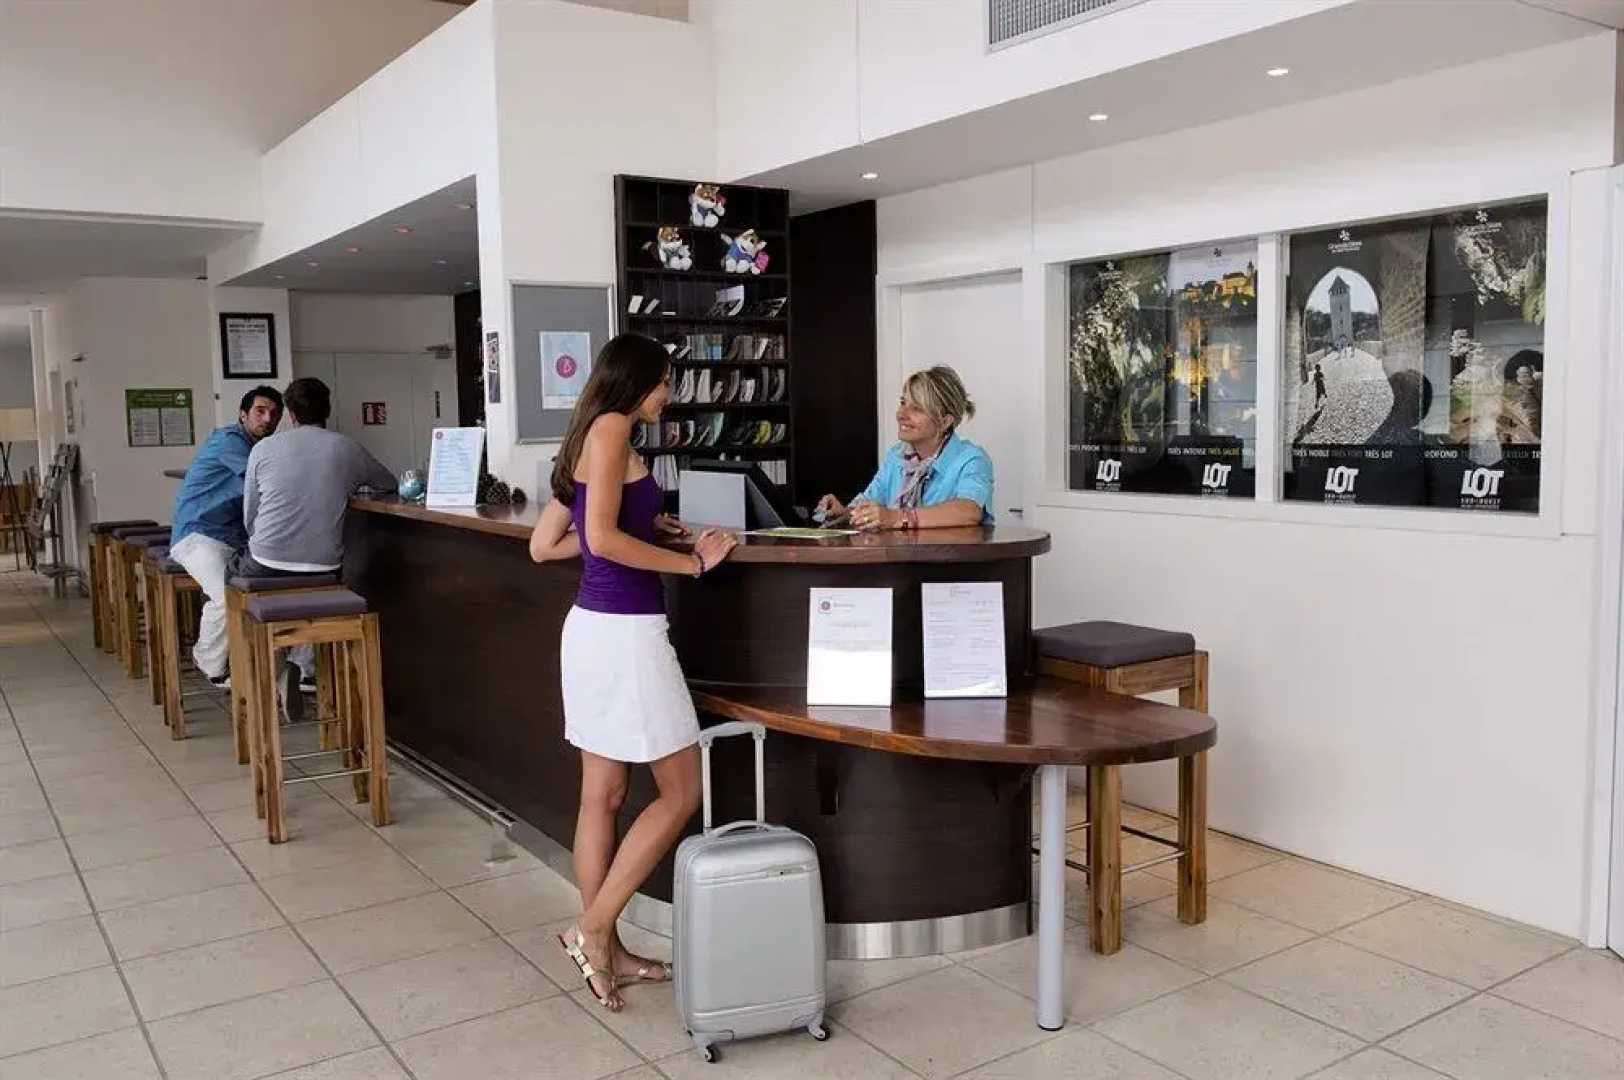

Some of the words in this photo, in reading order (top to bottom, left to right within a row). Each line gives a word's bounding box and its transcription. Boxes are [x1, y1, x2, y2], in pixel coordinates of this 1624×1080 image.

[1364, 449, 1380, 458] TRÈS
[1096, 458, 1122, 482] LOT
[1202, 462, 1231, 488] LOT
[1325, 466, 1359, 493] LOT
[1461, 467, 1505, 498] LOT
